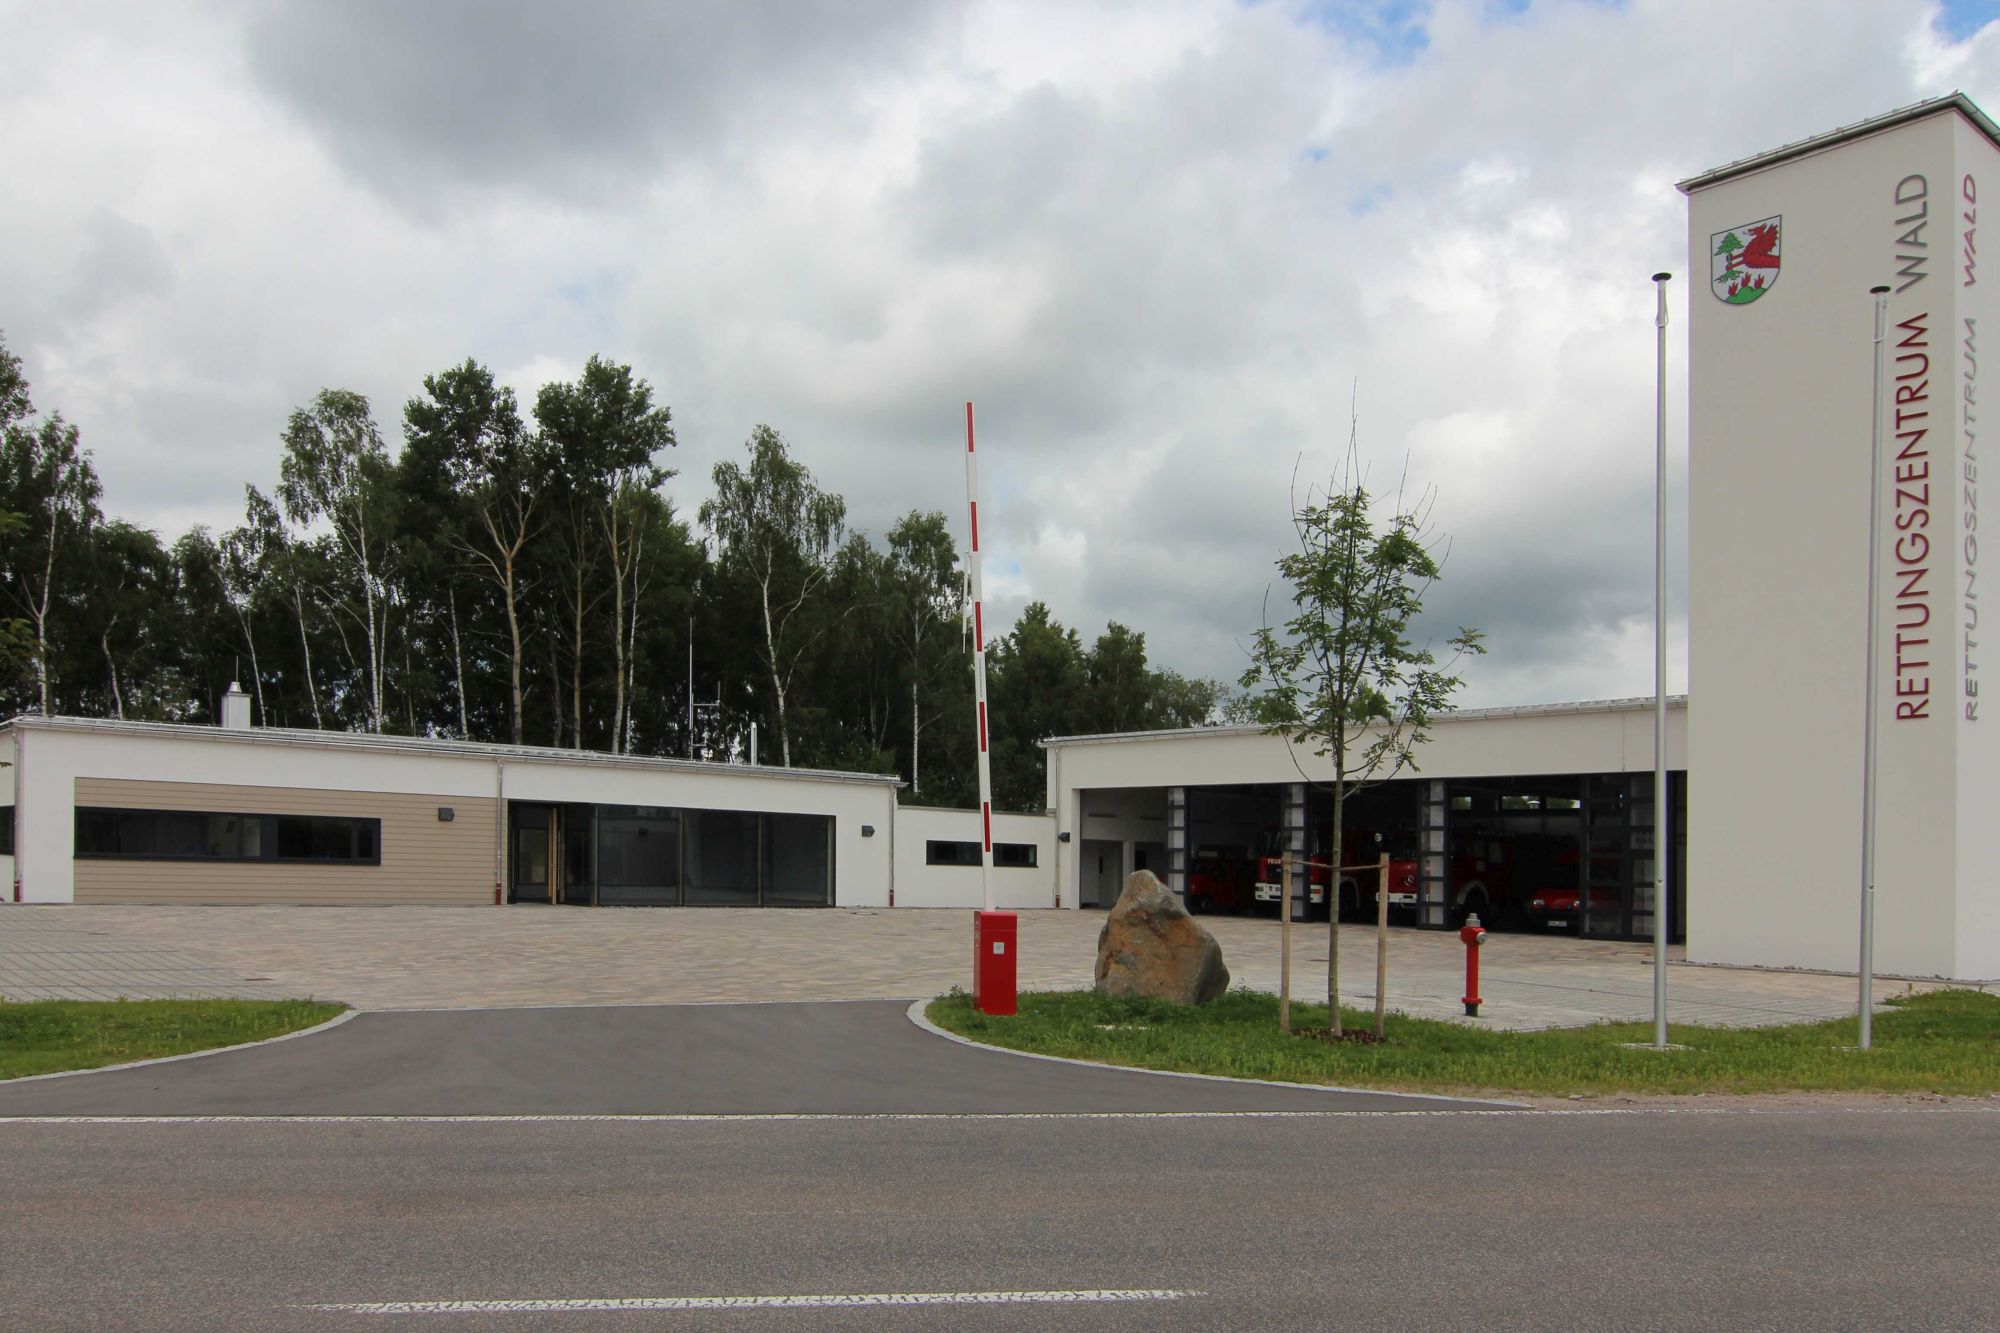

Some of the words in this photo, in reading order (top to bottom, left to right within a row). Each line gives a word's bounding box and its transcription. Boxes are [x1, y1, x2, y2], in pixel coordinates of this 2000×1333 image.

[1895, 174, 1928, 294] WALD
[1963, 173, 1977, 287] WALD
[1895, 312, 1929, 720] RETTUNGSZENTRUM
[1964, 317, 1978, 721] RETTUNGSZENTRUM
